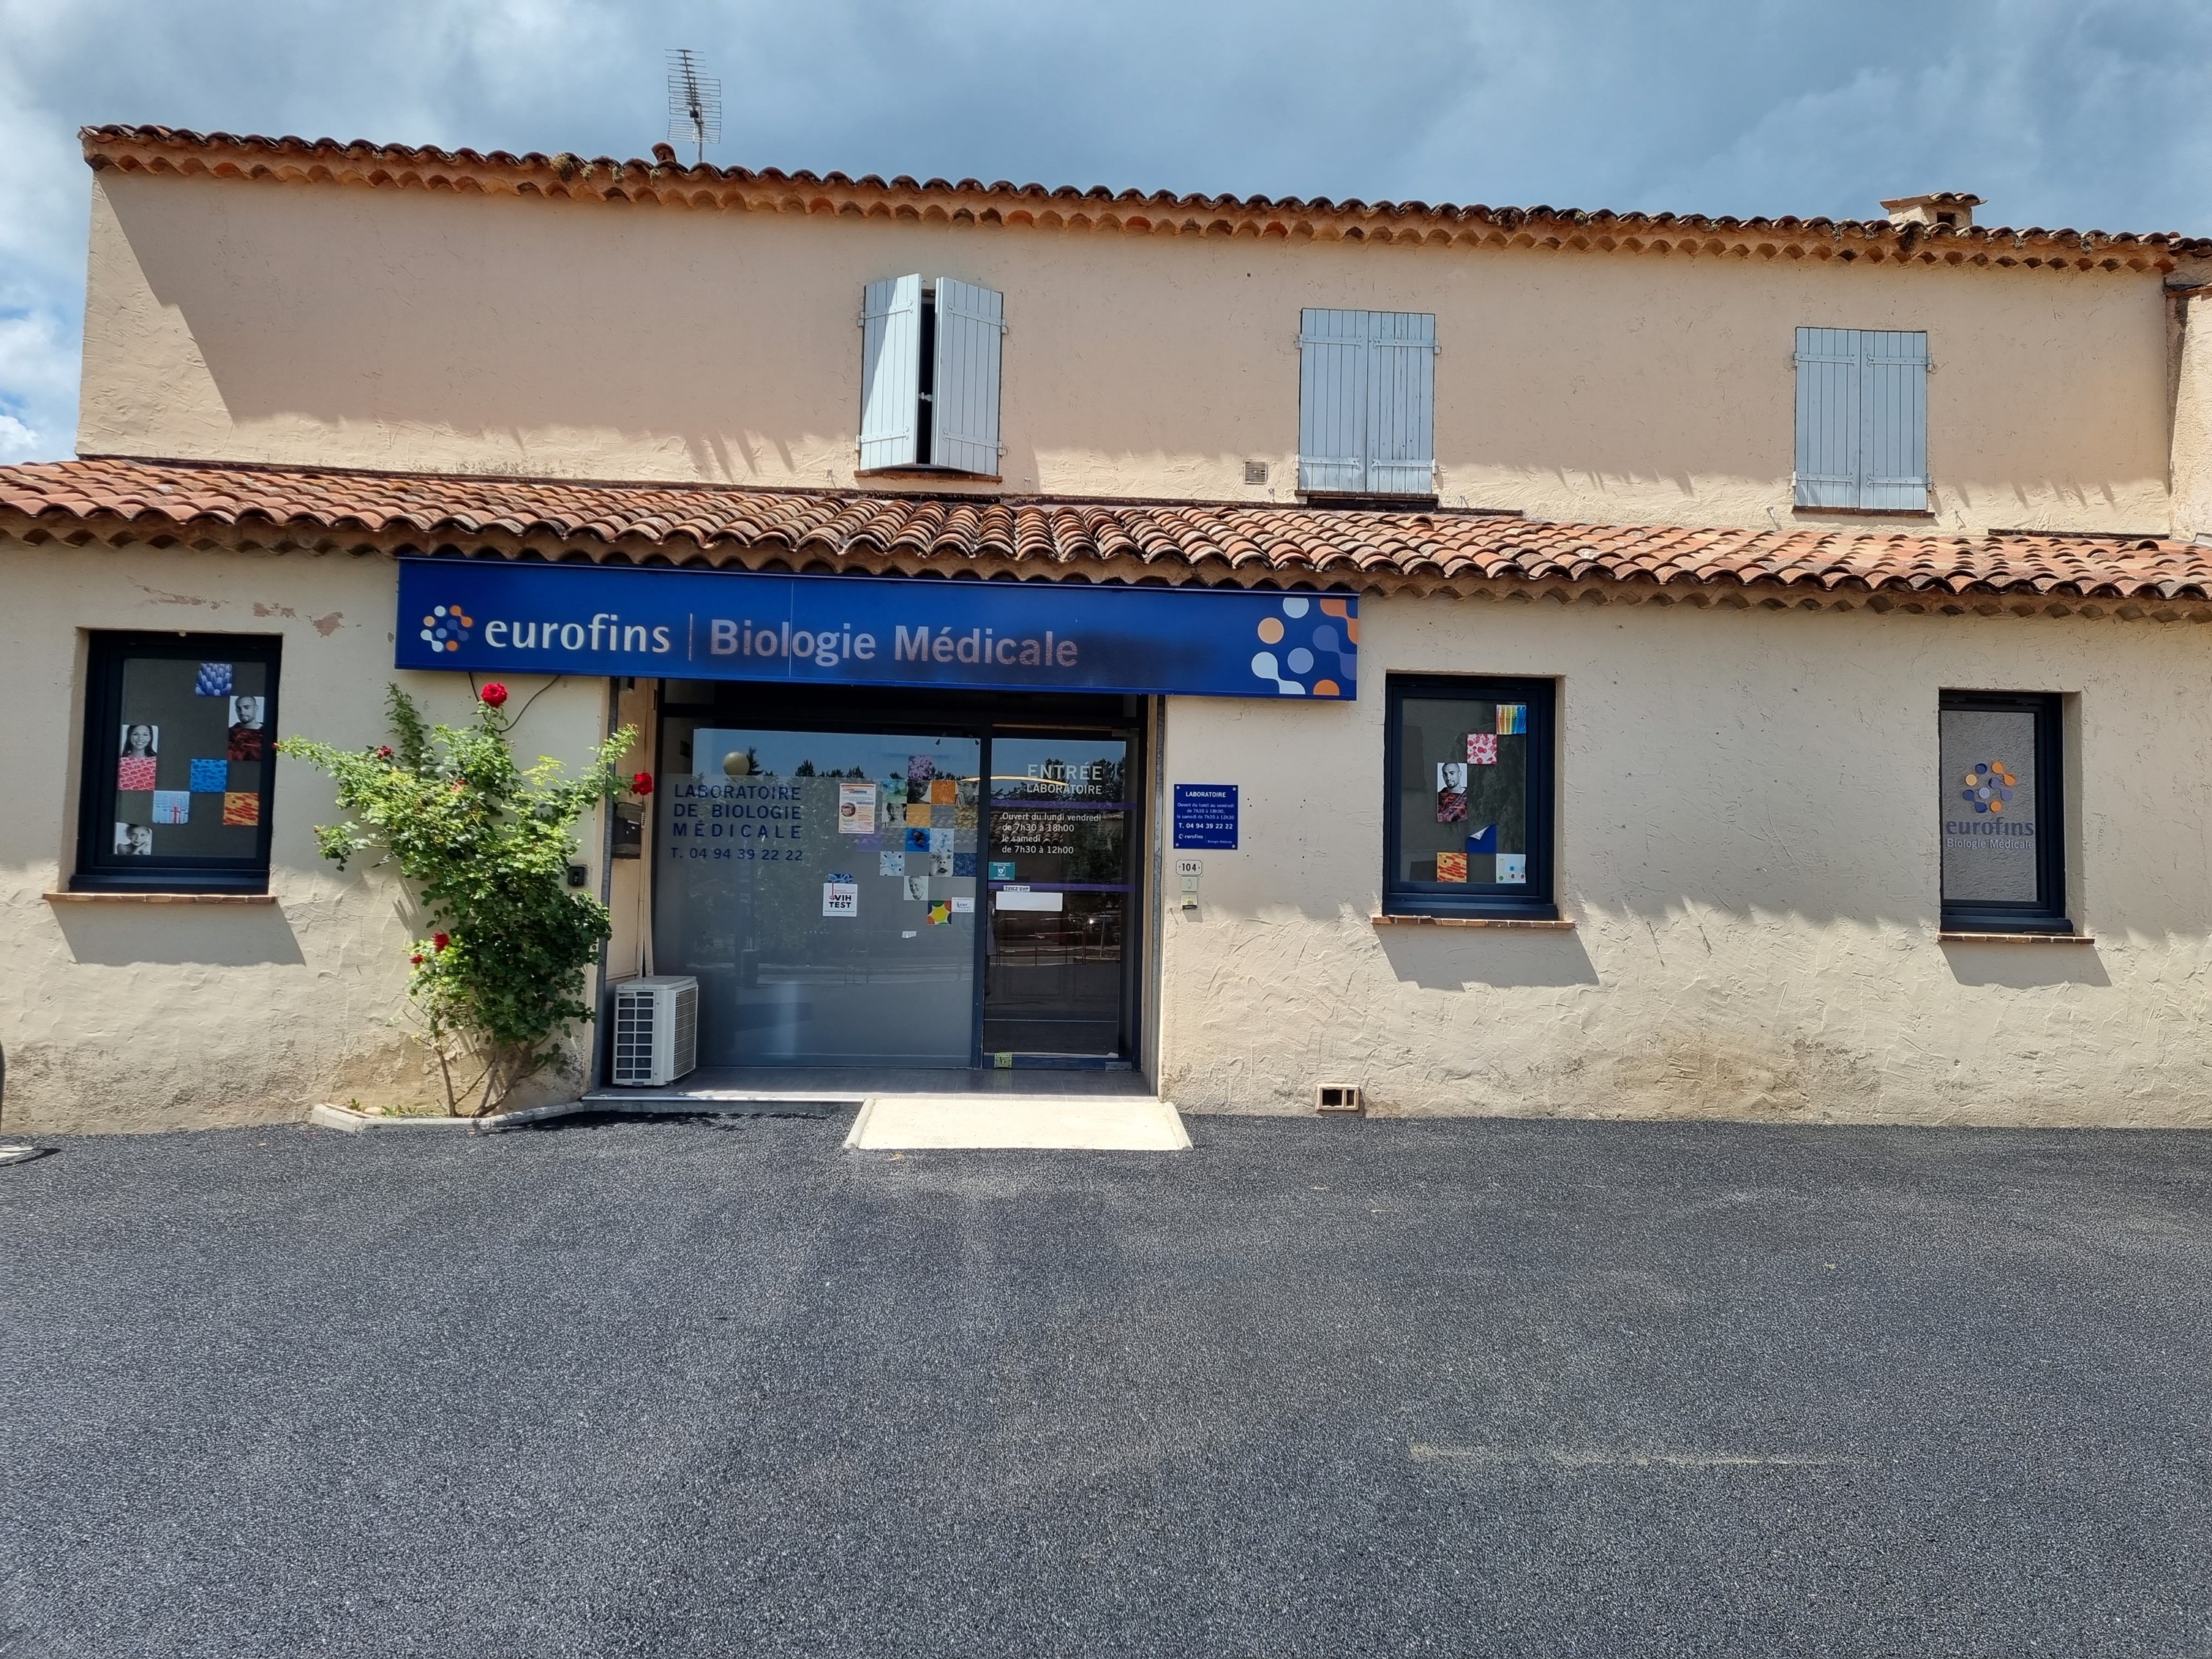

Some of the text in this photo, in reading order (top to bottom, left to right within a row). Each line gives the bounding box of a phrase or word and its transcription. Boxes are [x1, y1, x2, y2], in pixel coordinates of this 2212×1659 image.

[485, 613, 1078, 667] eurofins Biologie Médicale
[1027, 761, 1102, 780] ENTRÉE
[674, 784, 801, 800] LABORATOIRE
[1026, 783, 1102, 794] LABORATOIRE
[674, 803, 802, 819] DE BIOLOGIE
[1002, 812, 1102, 821] Ouvert du lundi vendredi
[673, 820, 801, 839] MÉDICALE
[1015, 824, 1037, 832] 7h30
[1040, 824, 1044, 832] à
[1047, 824, 1075, 832] 18h00
[1946, 817, 2034, 836] eurofins
[1012, 835, 1041, 843] samedi
[1946, 838, 2034, 850] Biologie Médicale
[670, 847, 802, 861] T. 04 94 39 22 22
[1015, 846, 1037, 854] 7h30
[1047, 846, 1074, 854] 12h00
[1181, 863, 1196, 871] 104
